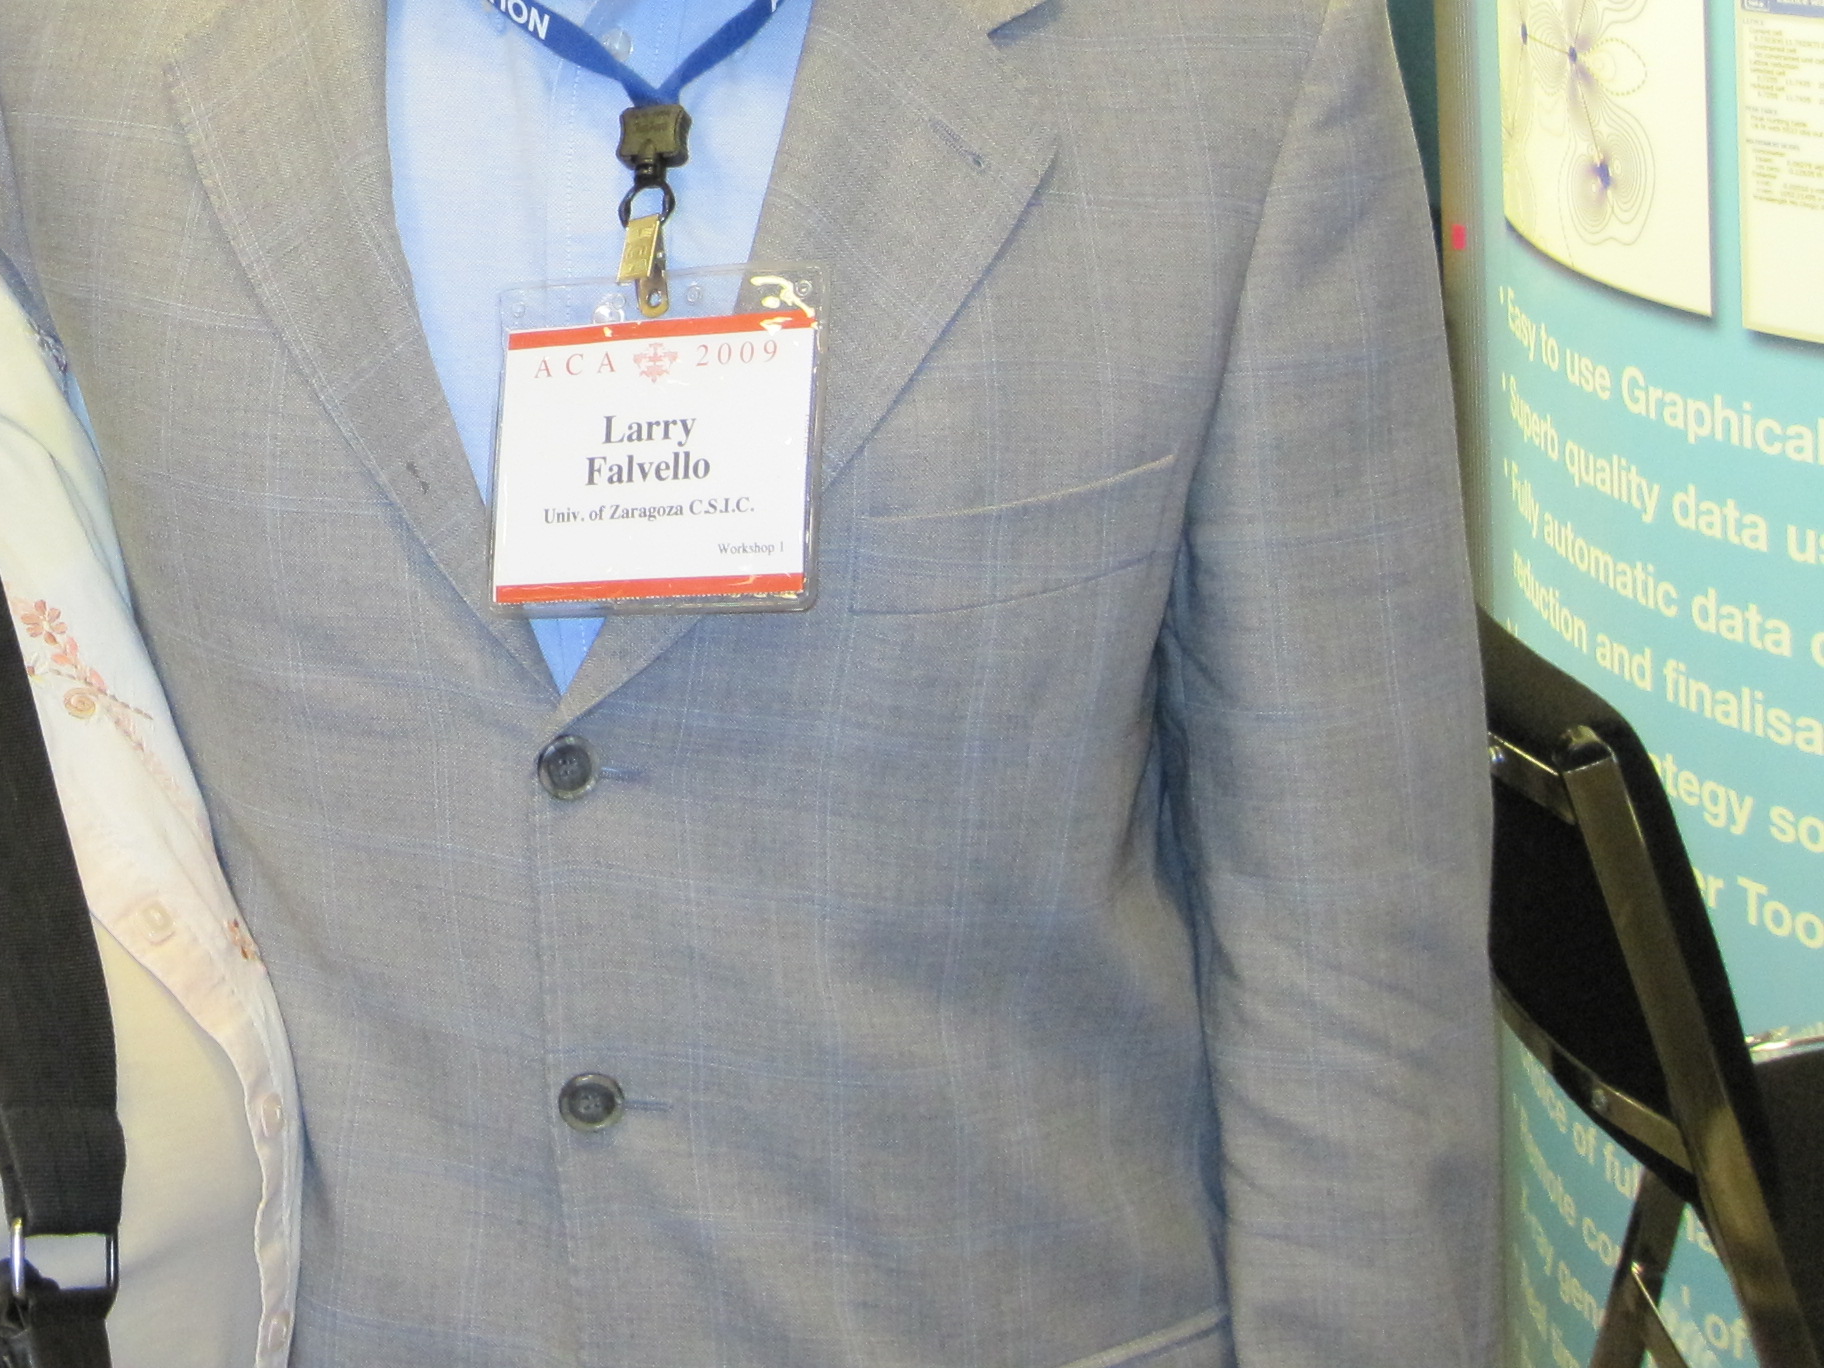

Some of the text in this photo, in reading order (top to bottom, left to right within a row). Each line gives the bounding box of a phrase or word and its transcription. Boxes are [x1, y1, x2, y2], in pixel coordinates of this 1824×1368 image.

[696, 339, 779, 368] 2009
[1508, 286, 1824, 466] Easy to use Graphical
[602, 414, 697, 448] Larry
[585, 451, 711, 486] Falvello
[1510, 374, 1560, 462] Superb
[1564, 438, 1661, 524] quality
[1672, 483, 1769, 553] data
[544, 507, 586, 524] Univ.
[589, 505, 605, 521] of
[609, 501, 684, 522] Zaragoza
[717, 541, 776, 556] Workshop
[1511, 460, 1539, 539] Fully
[1543, 511, 1679, 618] automatic
[1691, 586, 1793, 658] data
[1513, 549, 1824, 756] reduction and finalisa
[1737, 875, 1824, 949] Too
